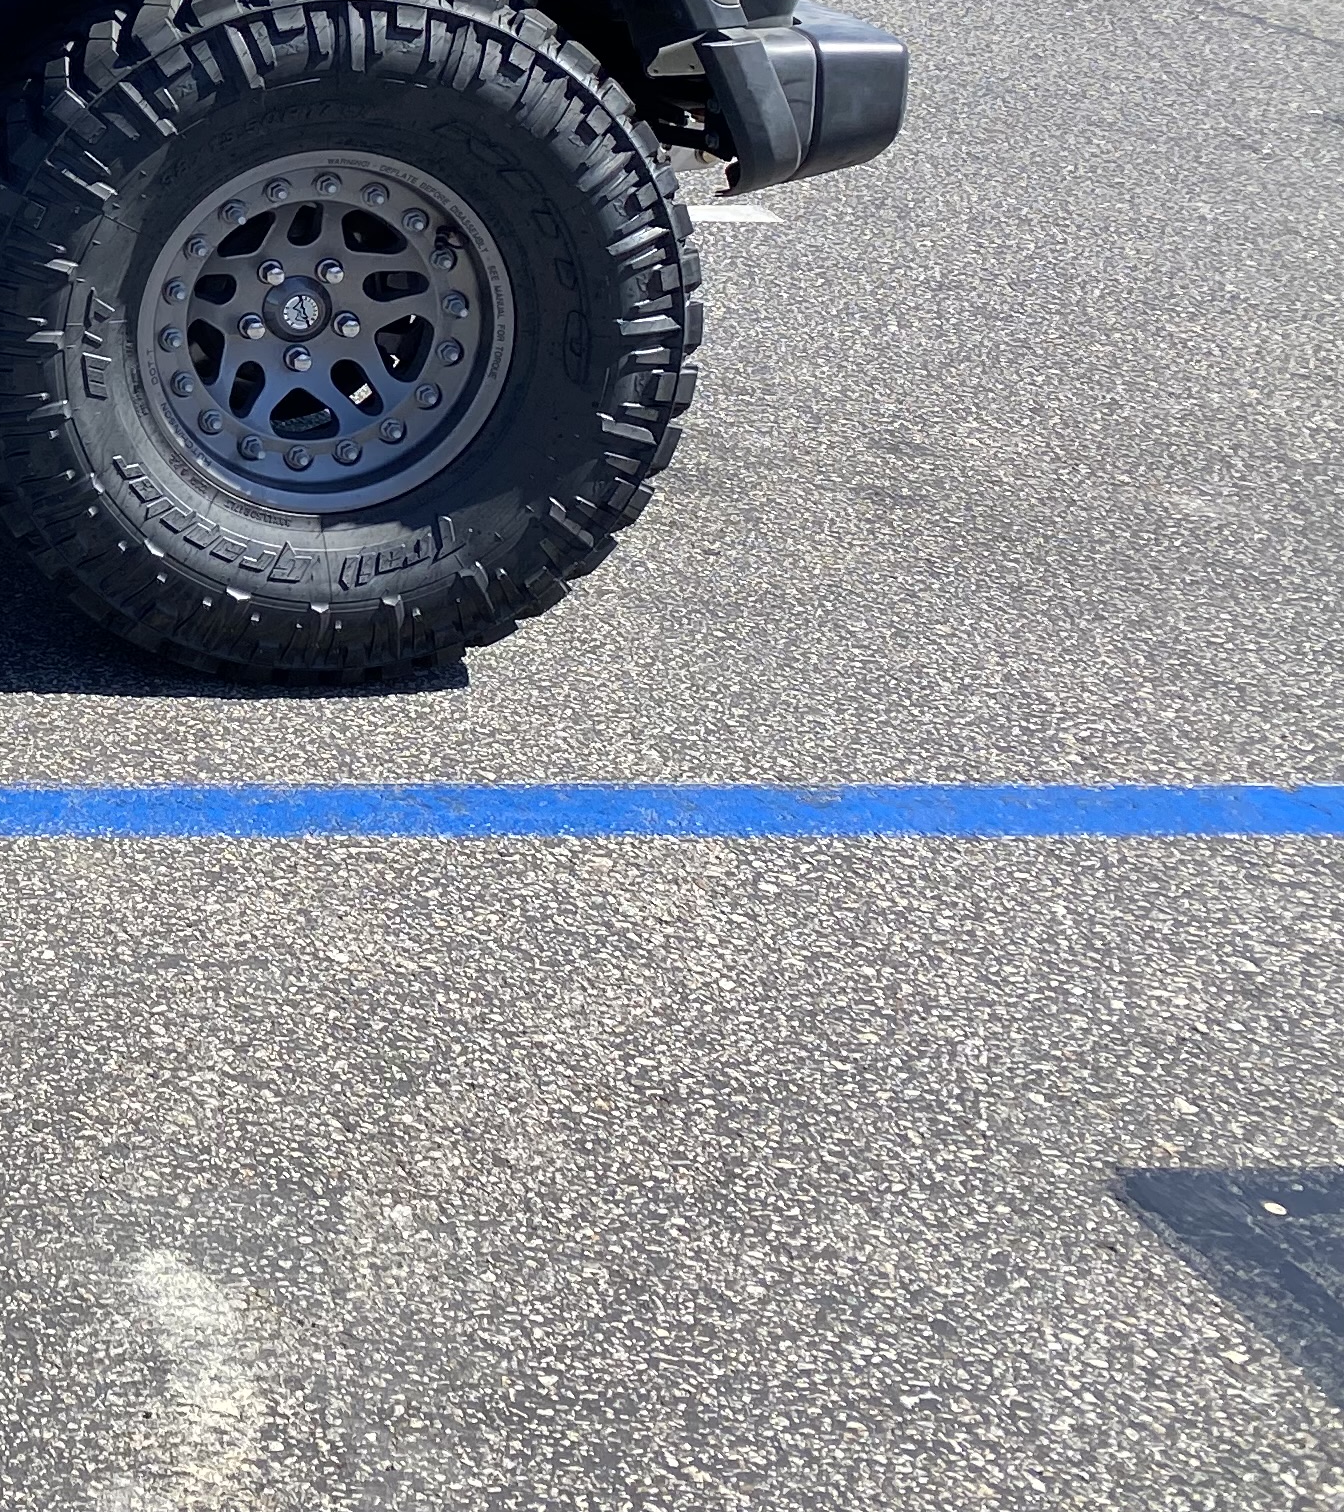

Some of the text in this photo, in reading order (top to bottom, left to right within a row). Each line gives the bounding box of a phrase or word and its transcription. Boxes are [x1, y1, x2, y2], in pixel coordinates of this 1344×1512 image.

[379, 164, 418, 186] DEFLATE
[419, 182, 451, 206] BEFORE
[449, 205, 490, 253] DISASSEMBLY
[487, 265, 500, 282] SEE
[494, 285, 507, 320] MANUAL
[496, 324, 506, 342] FOR
[488, 346, 503, 380] TORQUE
[161, 402, 213, 467] HUTCHINSON
[113, 454, 315, 585] Grappler
[336, 512, 469, 592] Trail
